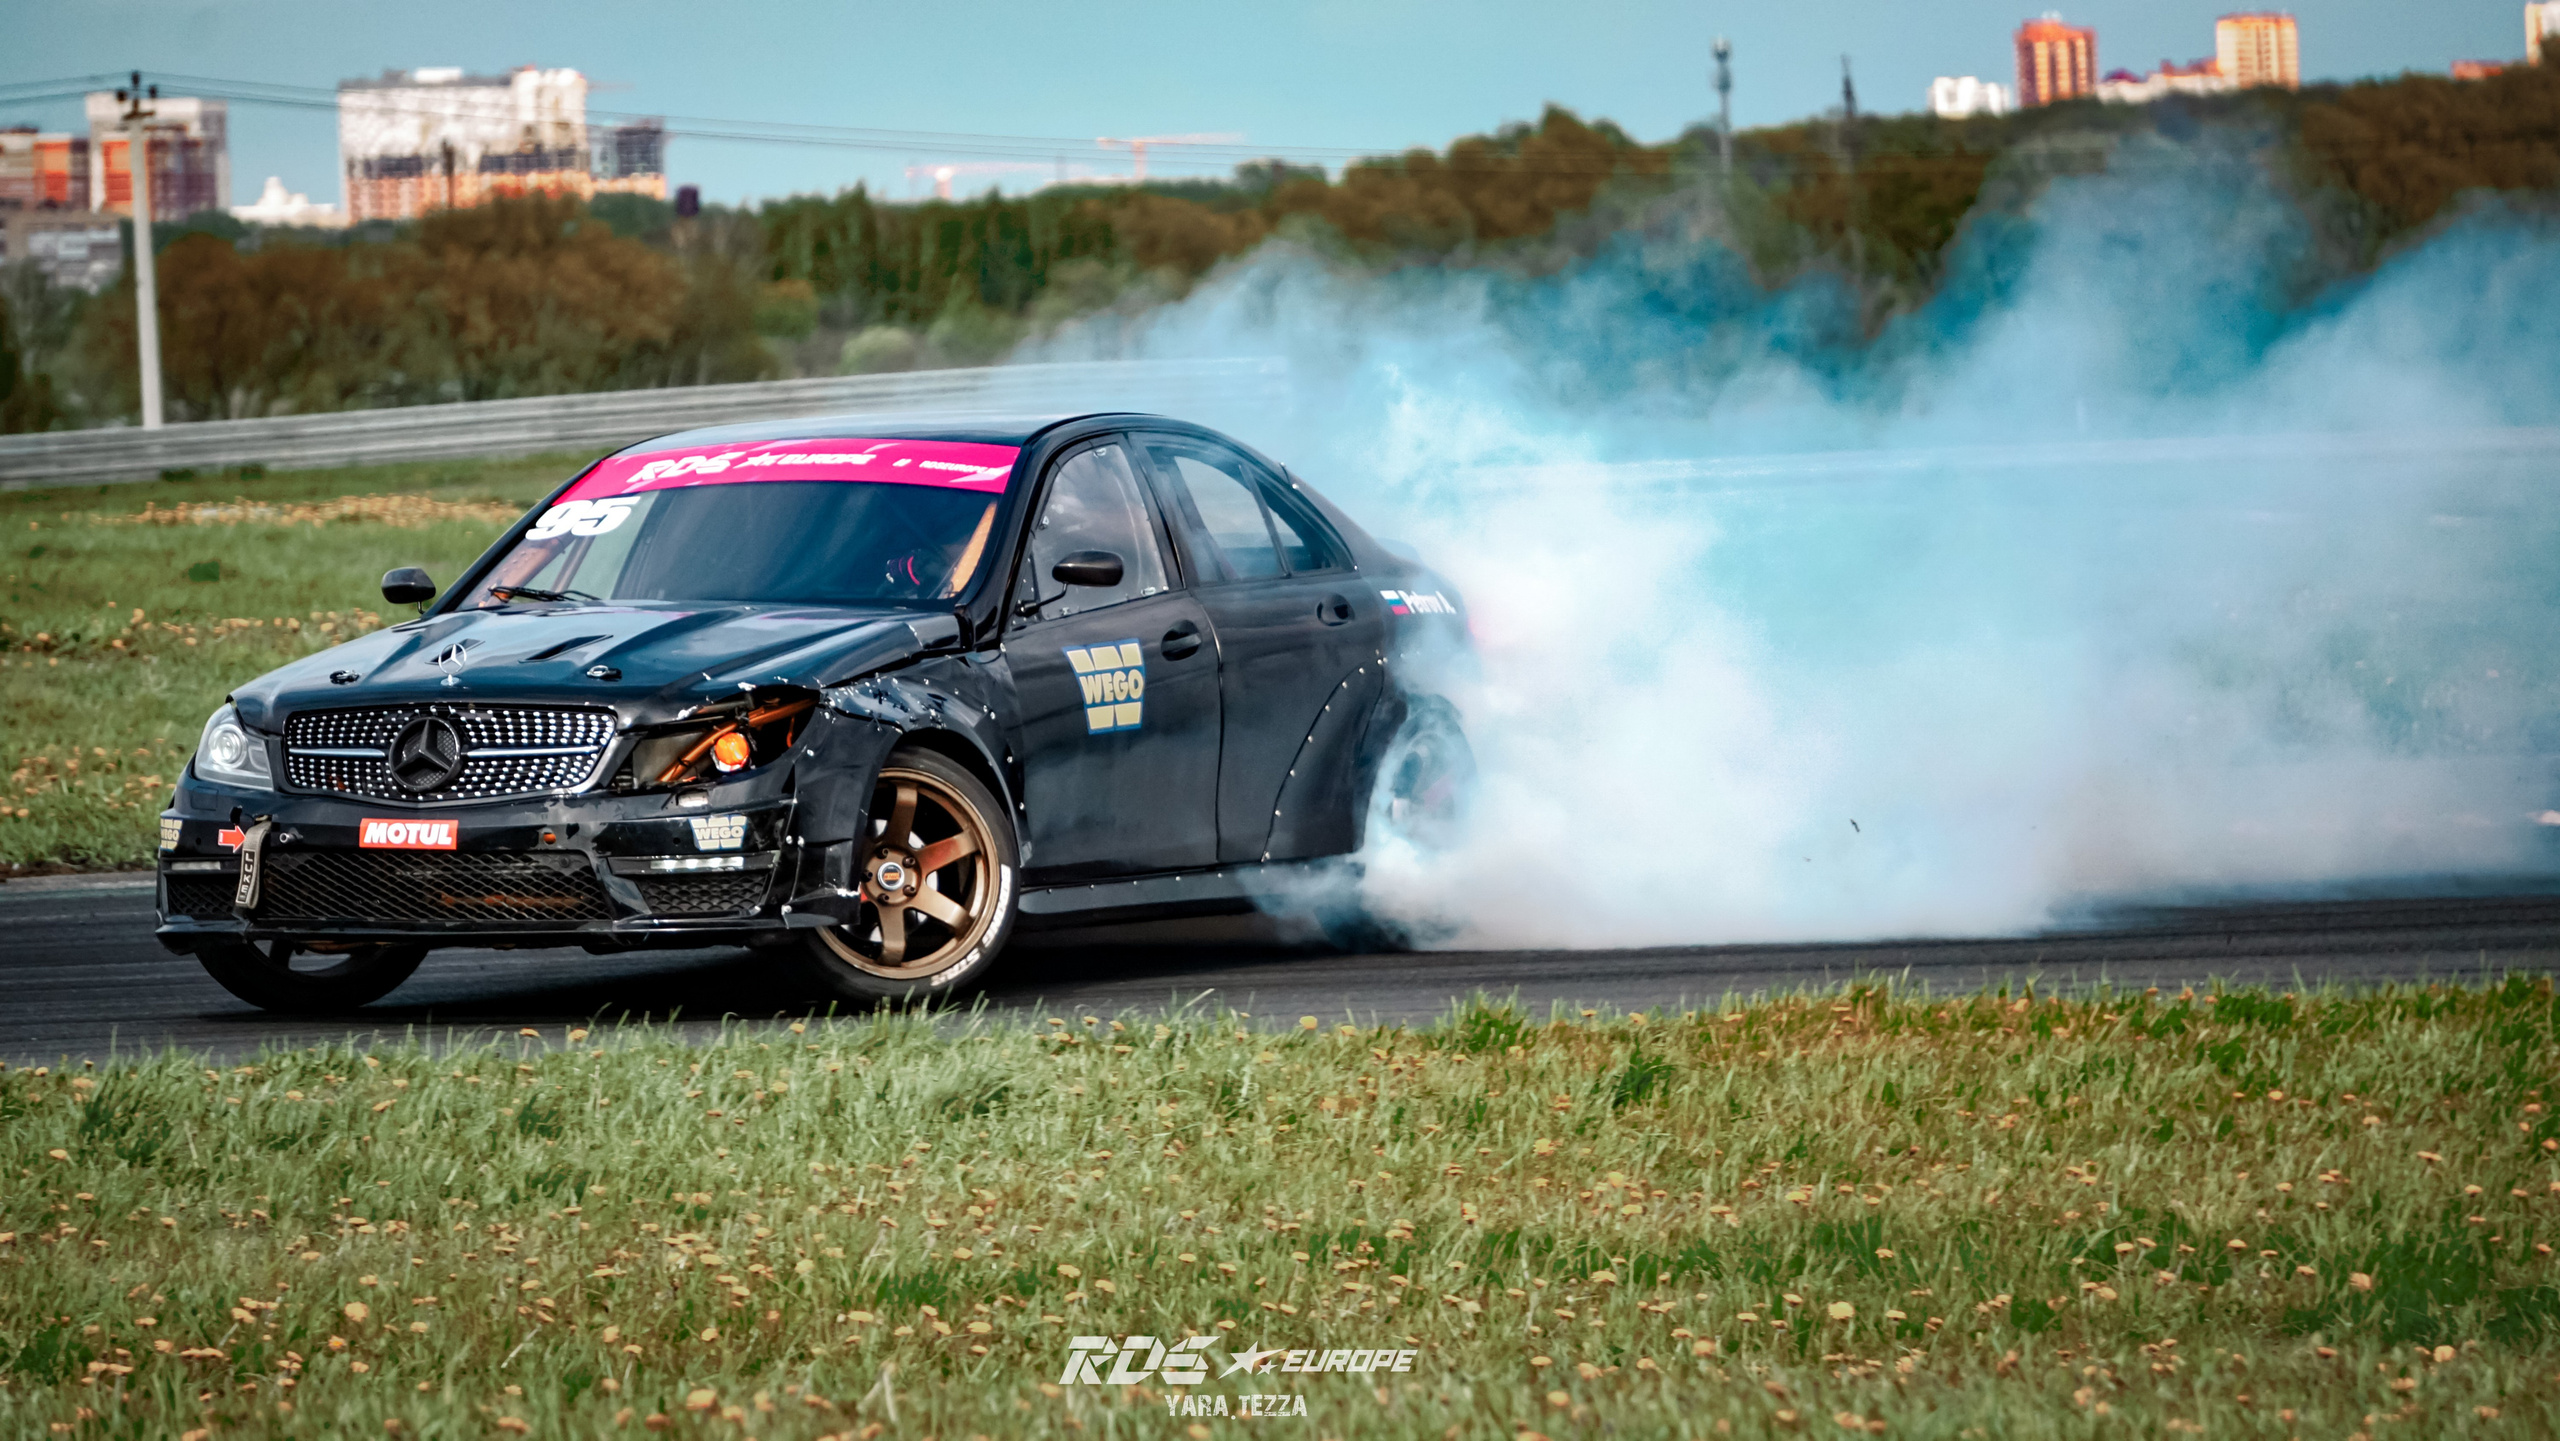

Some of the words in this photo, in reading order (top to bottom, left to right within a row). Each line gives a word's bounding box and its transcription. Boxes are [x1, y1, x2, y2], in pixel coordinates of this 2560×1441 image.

[626, 451, 747, 483] RDS
[777, 453, 877, 466] EUROPE
[525, 496, 641, 540] 95
[1079, 669, 1144, 704] WEGO
[363, 822, 452, 845] MOTUL
[694, 826, 744, 840] WEGO
[240, 852, 254, 894] LUKE
